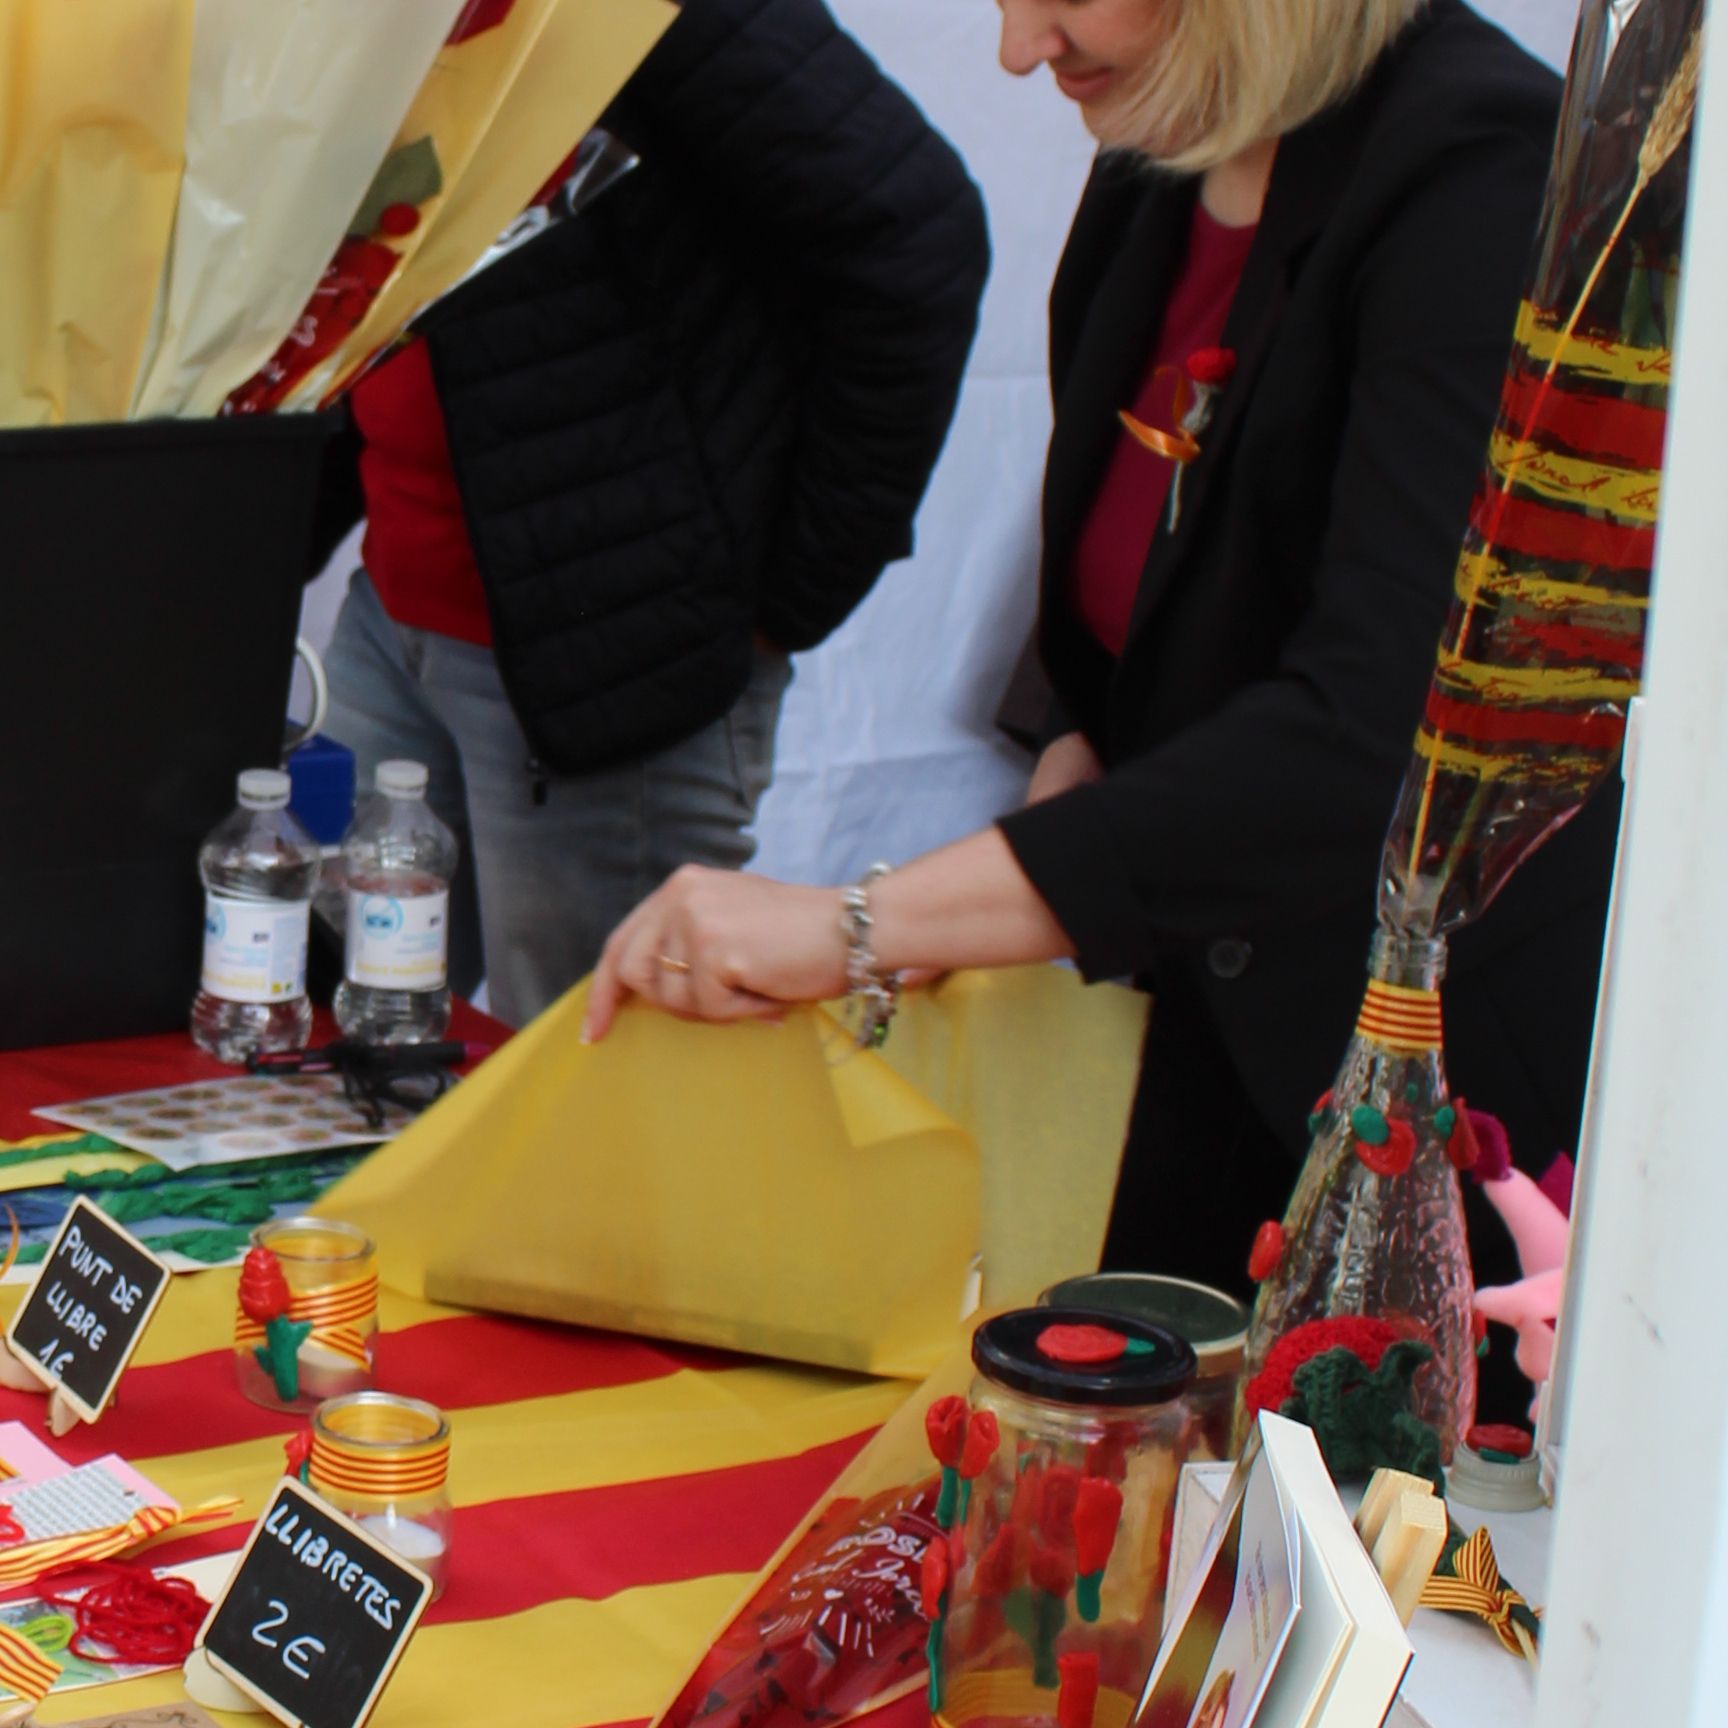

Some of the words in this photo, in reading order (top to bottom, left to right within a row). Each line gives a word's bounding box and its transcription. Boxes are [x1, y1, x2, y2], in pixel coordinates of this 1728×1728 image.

[59, 1225, 113, 1287] PUNT
[110, 1274, 143, 1314] DE
[46, 1280, 108, 1352] LLIBRE
[264, 1503, 401, 1631] LLIBRETES
[251, 1599, 326, 1680] 2€
